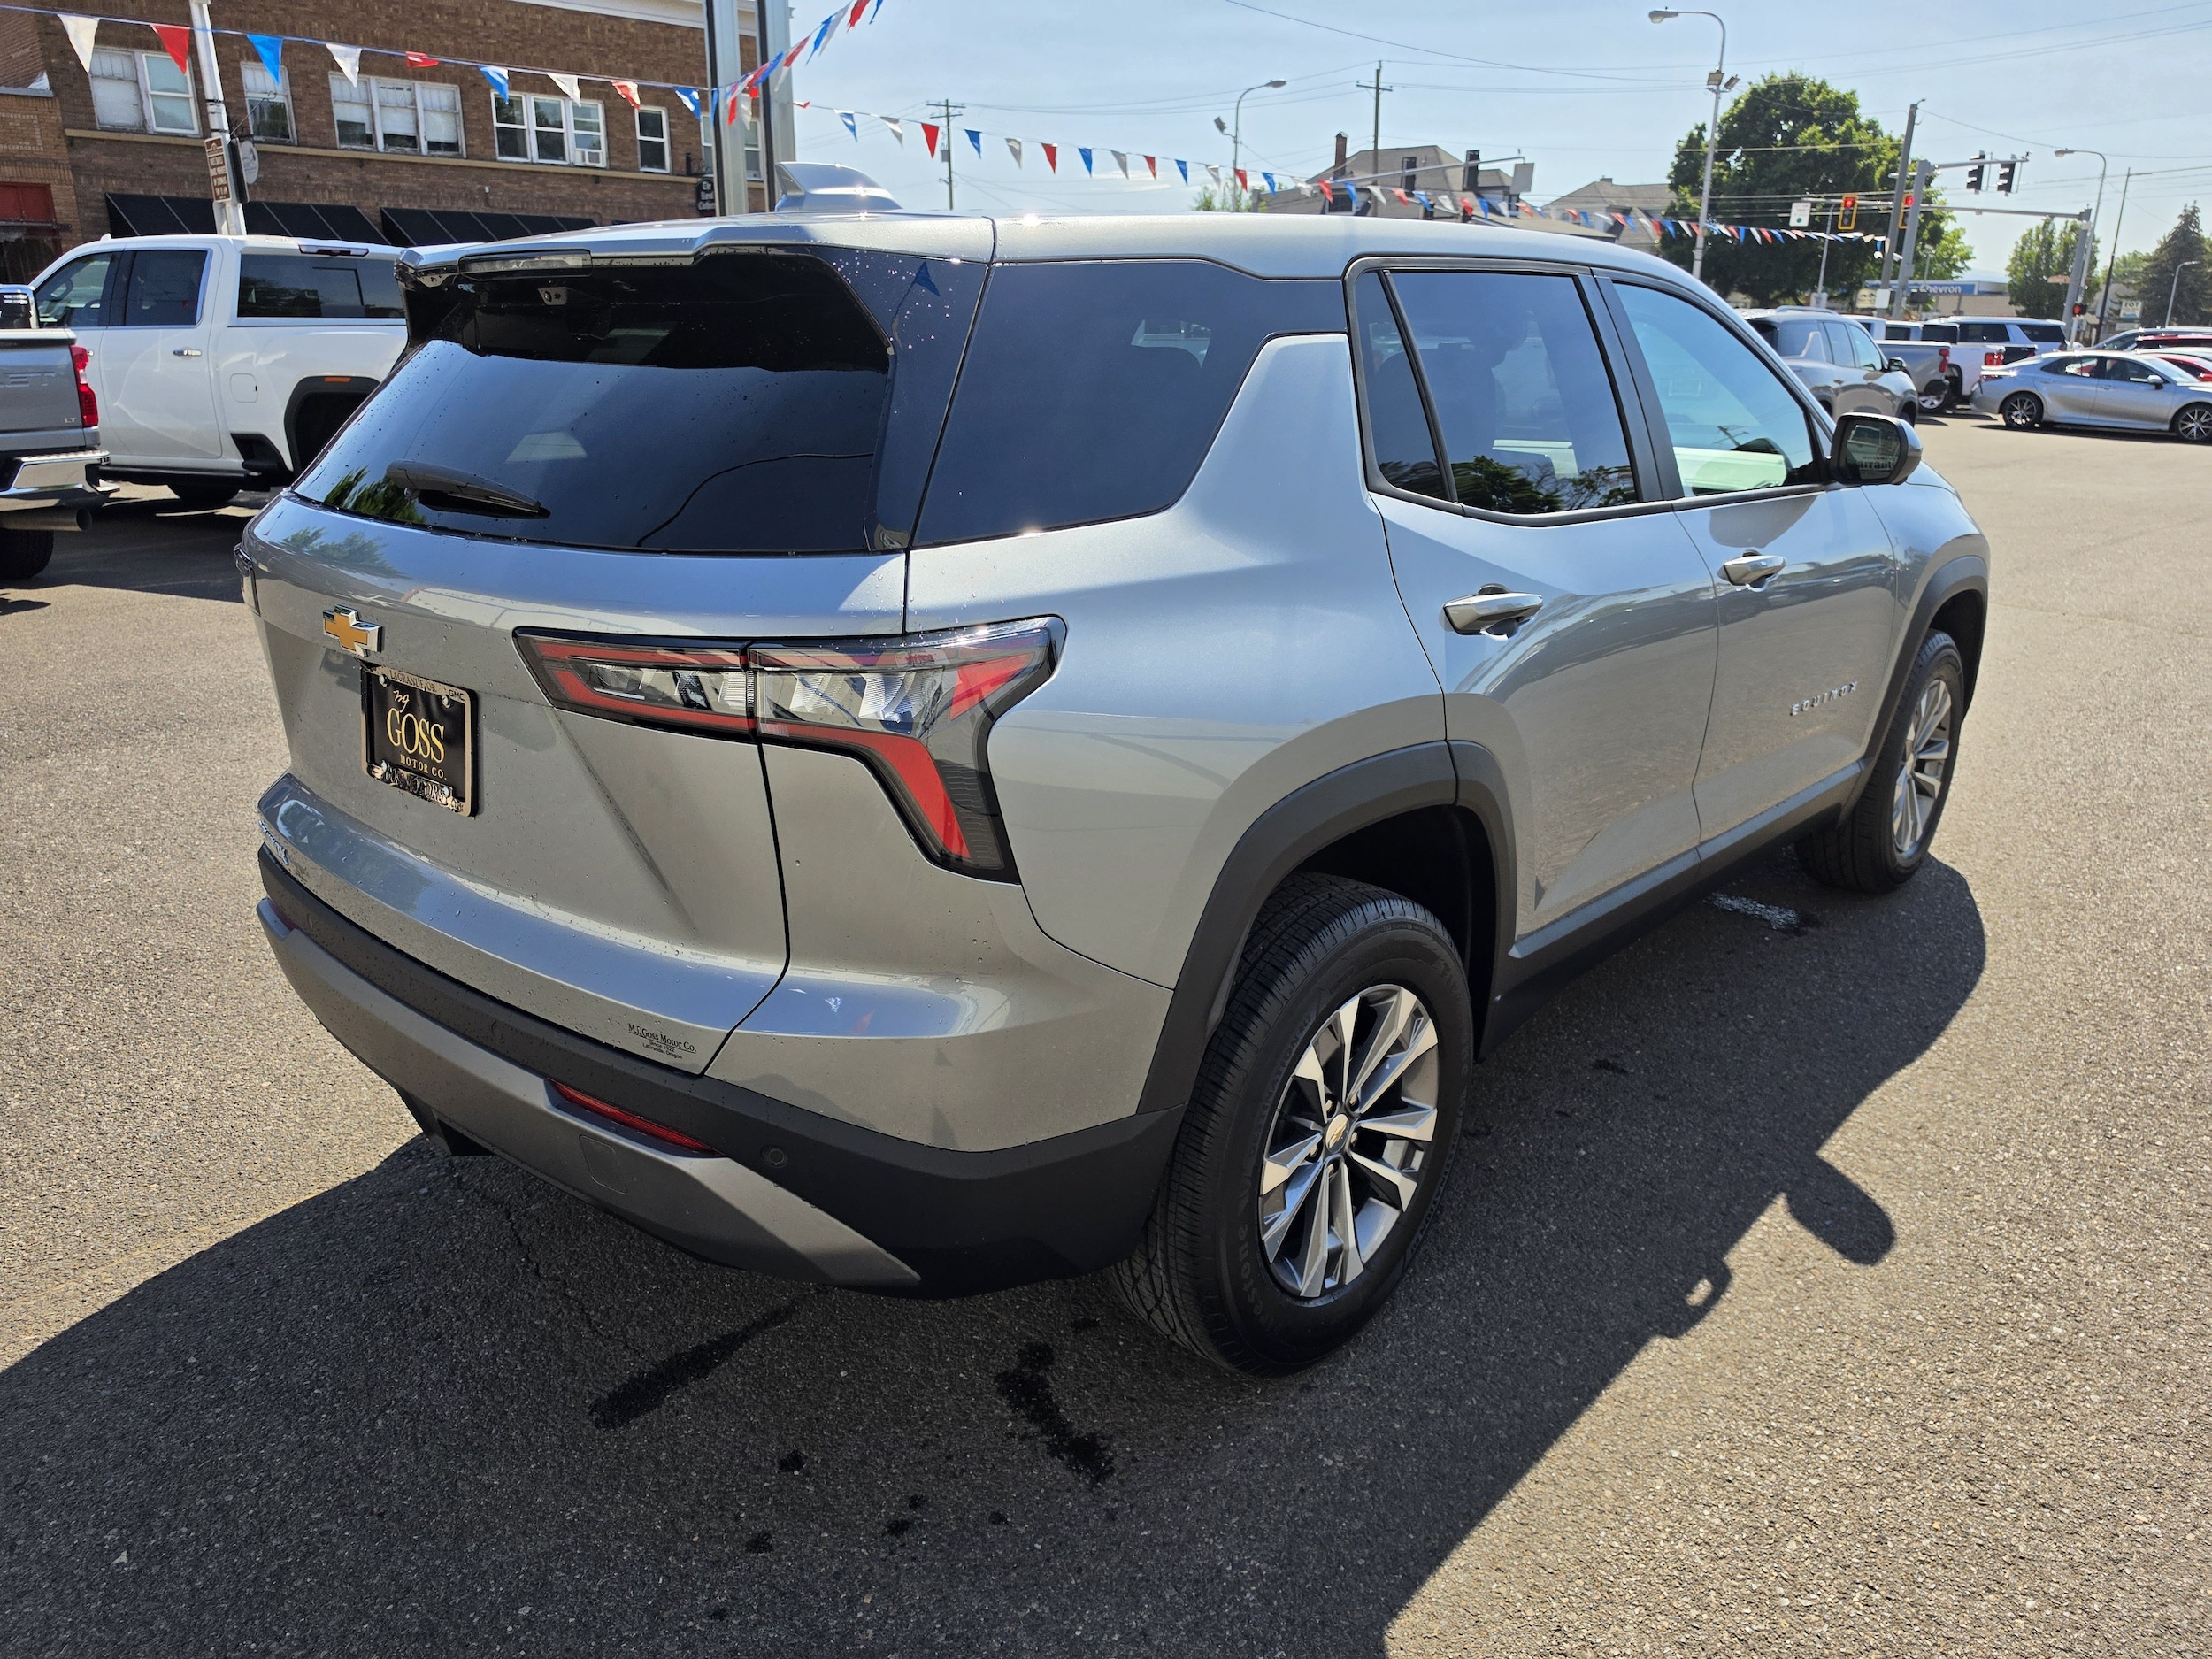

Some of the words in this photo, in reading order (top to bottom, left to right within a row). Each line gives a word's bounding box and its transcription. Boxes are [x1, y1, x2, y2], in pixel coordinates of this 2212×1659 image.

[1919, 284, 1962, 294] Chevron
[449, 688, 465, 701] GMC
[1789, 680, 1857, 716] EQUINOX
[387, 708, 445, 764] GOSS
[400, 754, 428, 772] MOTOR
[431, 767, 447, 780] CO.
[641, 1028, 658, 1041] Goss
[660, 1034, 682, 1048] Motor
[683, 1041, 697, 1052] Co.
